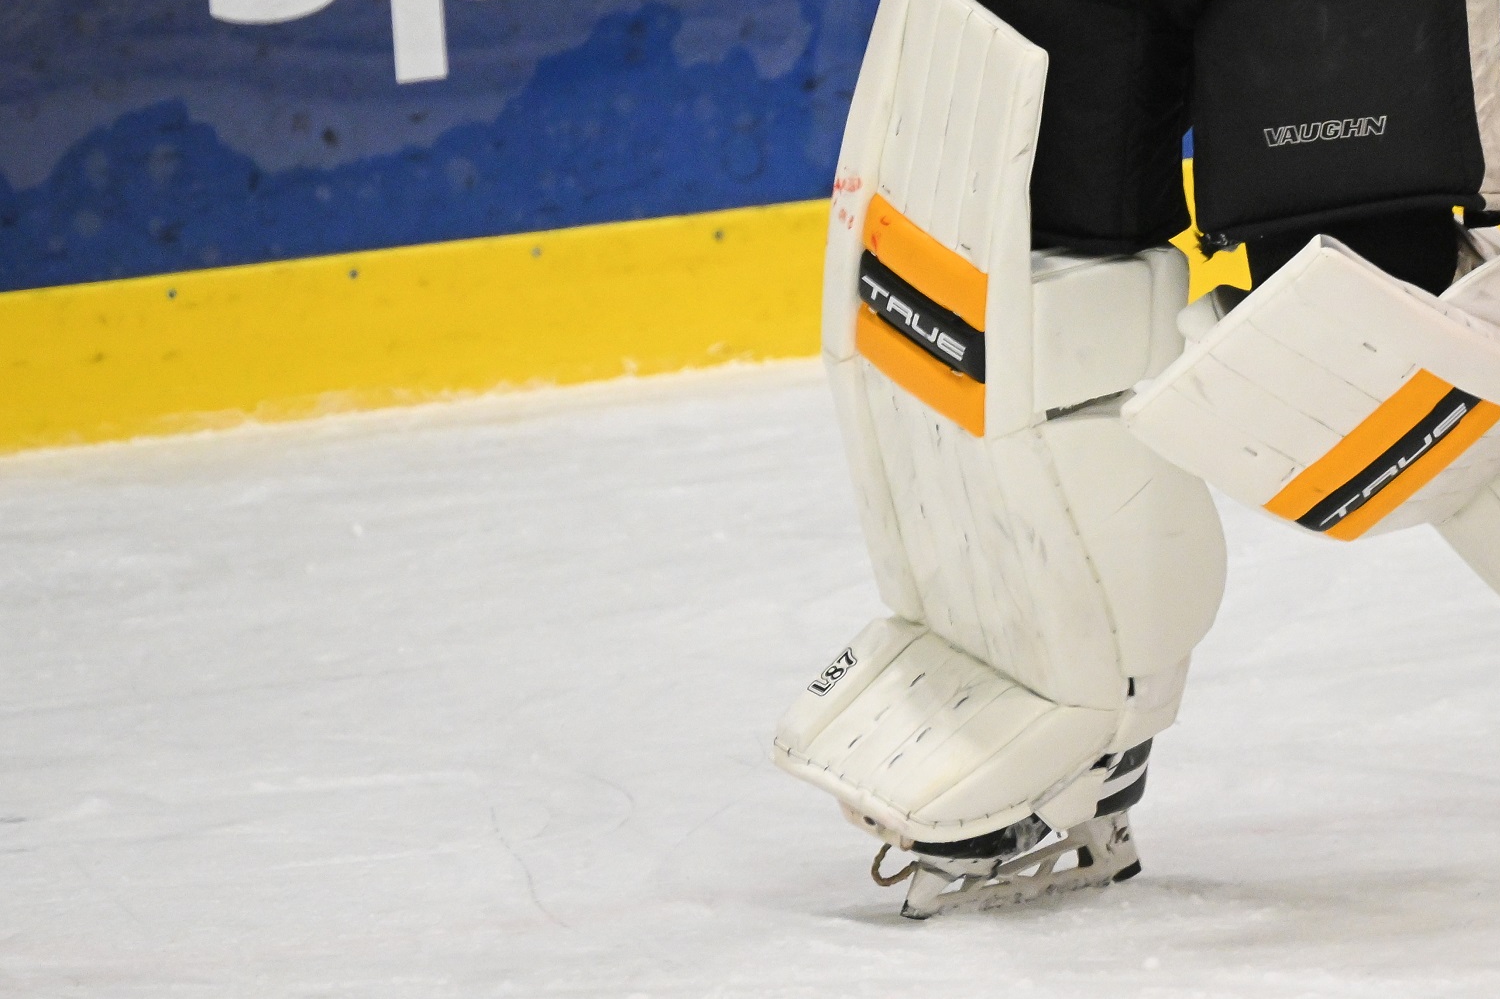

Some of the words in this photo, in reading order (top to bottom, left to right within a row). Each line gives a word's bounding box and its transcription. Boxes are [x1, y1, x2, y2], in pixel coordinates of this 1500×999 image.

[1263, 115, 1387, 147] VAUGHN
[861, 274, 967, 361] TRUE
[1319, 402, 1468, 528] TRUE
[807, 647, 858, 697] L87
